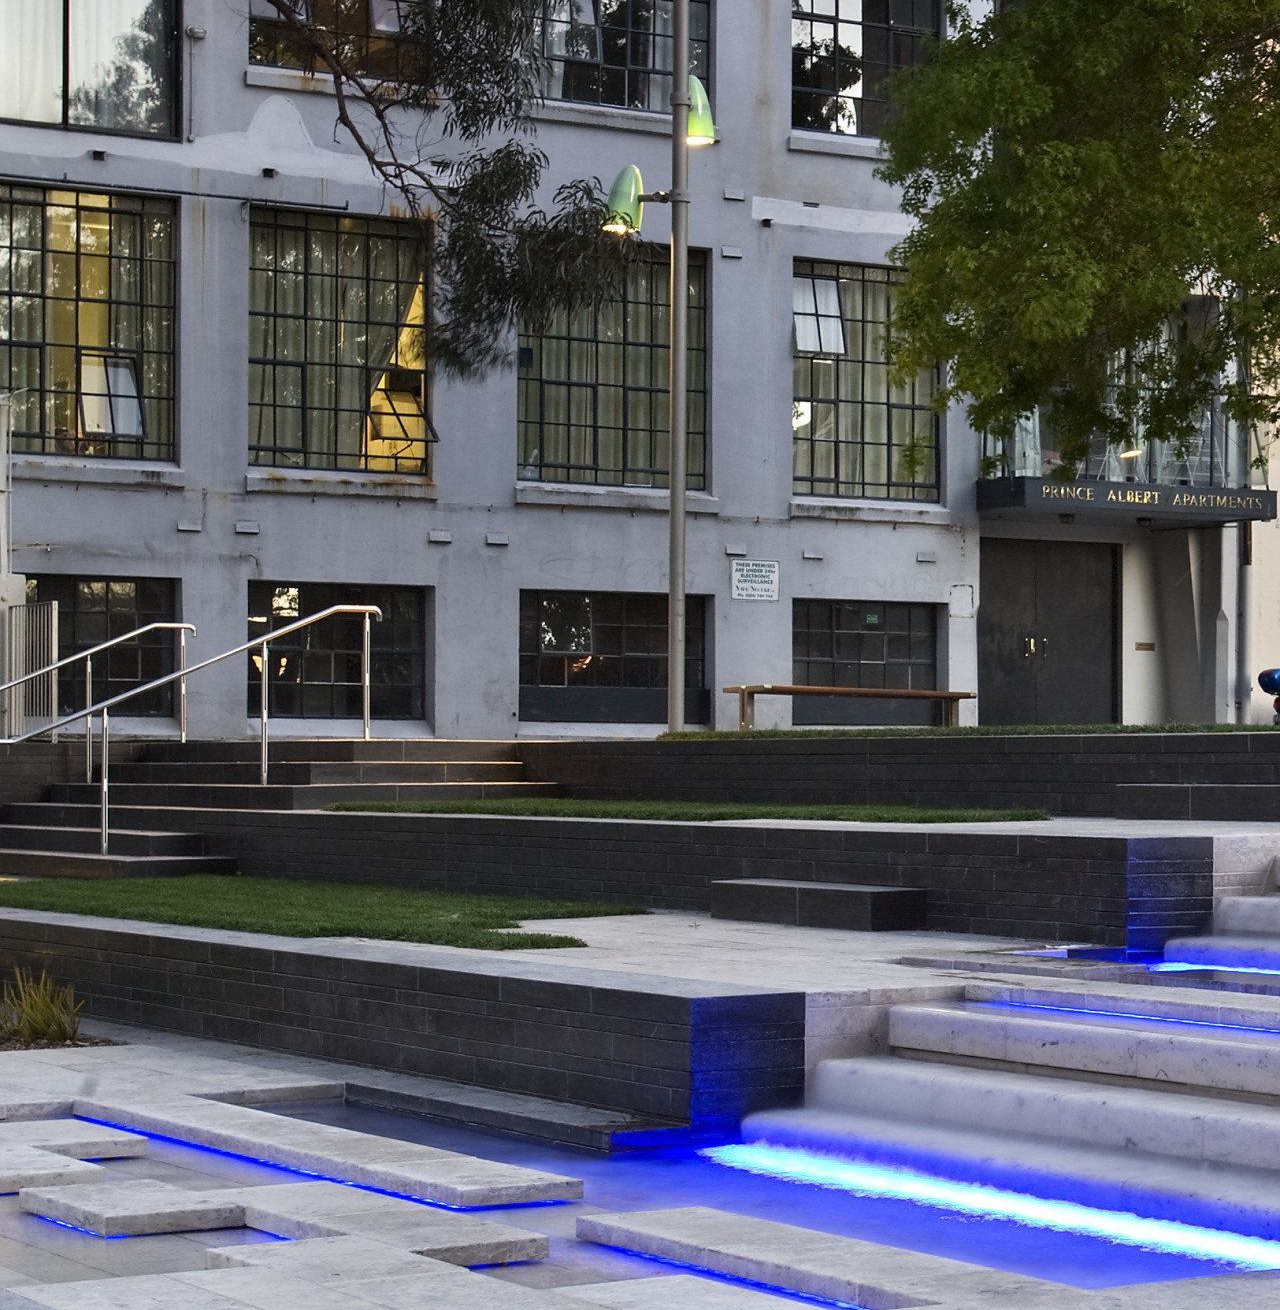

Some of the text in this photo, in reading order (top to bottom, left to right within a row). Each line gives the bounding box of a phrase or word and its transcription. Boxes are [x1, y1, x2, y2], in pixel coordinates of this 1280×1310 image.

[1042, 485, 1263, 510] PRINCE ALBERT APARTMENTS
